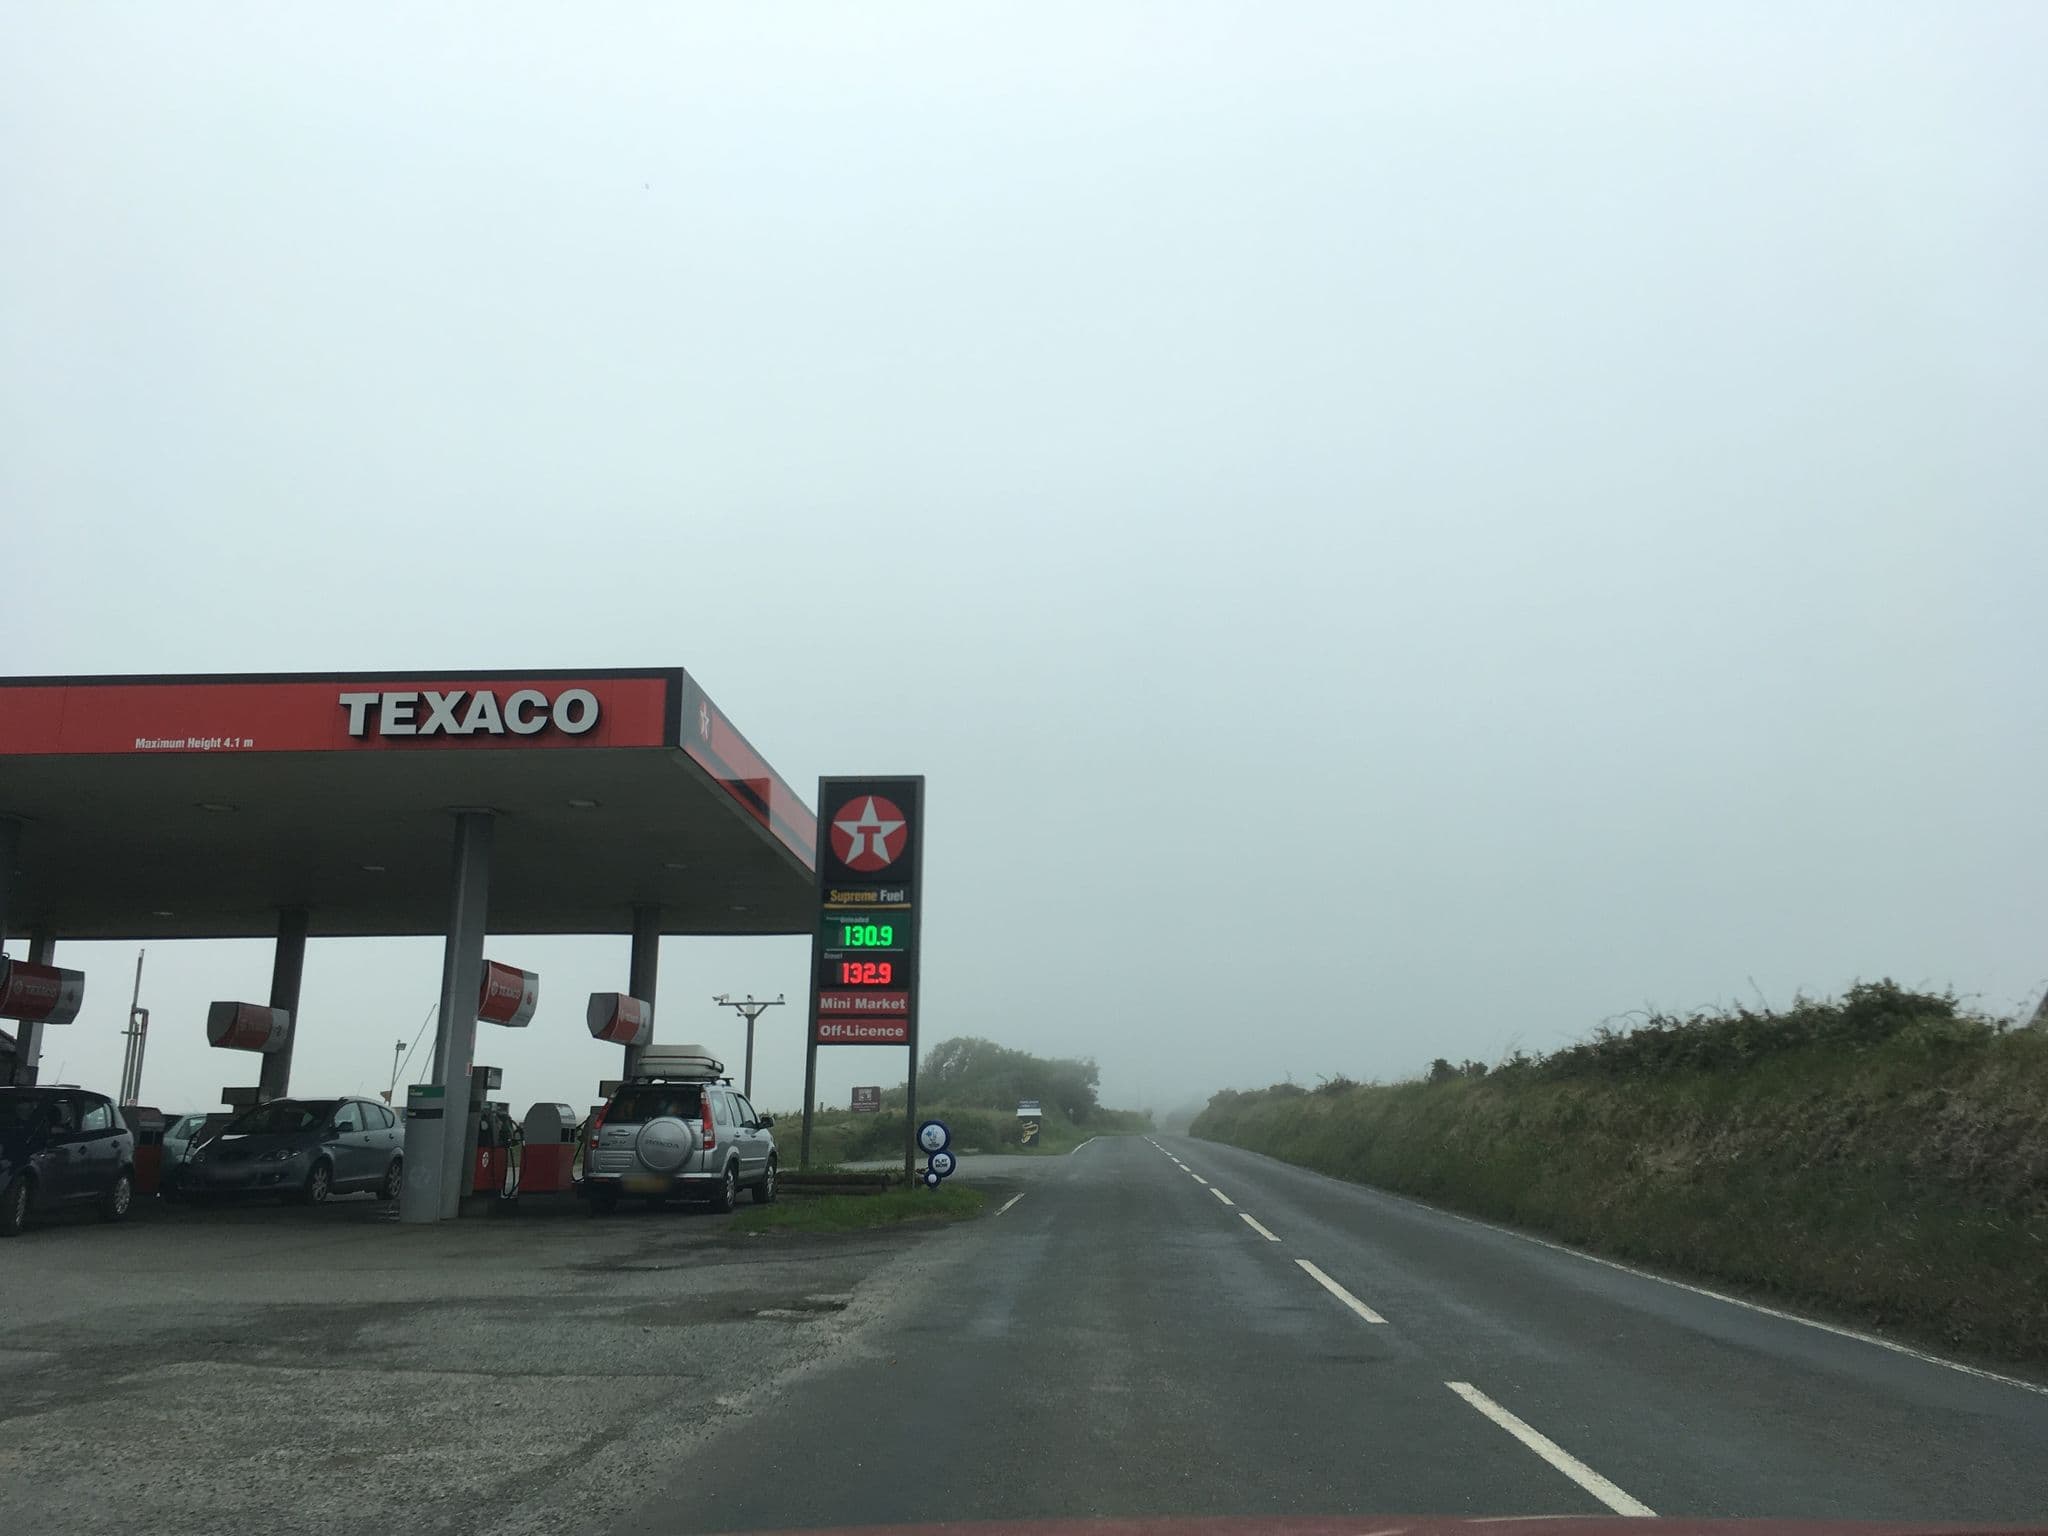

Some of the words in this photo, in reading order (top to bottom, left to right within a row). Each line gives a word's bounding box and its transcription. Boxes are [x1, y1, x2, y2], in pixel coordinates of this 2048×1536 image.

[339, 688, 600, 736] TEXACO
[135, 738, 185, 749] Maximum
[187, 737, 221, 750] Height
[224, 737, 240, 748] 4.1
[243, 739, 254, 748] m
[830, 889, 878, 903] Supreme
[880, 889, 904, 902] Fuel
[844, 925, 893, 946] 130.9
[842, 962, 892, 984] 132.9
[820, 998, 851, 1009] Mini
[855, 998, 906, 1009] Market
[820, 1024, 904, 1037] Off-Licence
[644, 1139, 680, 1149] HONDA
